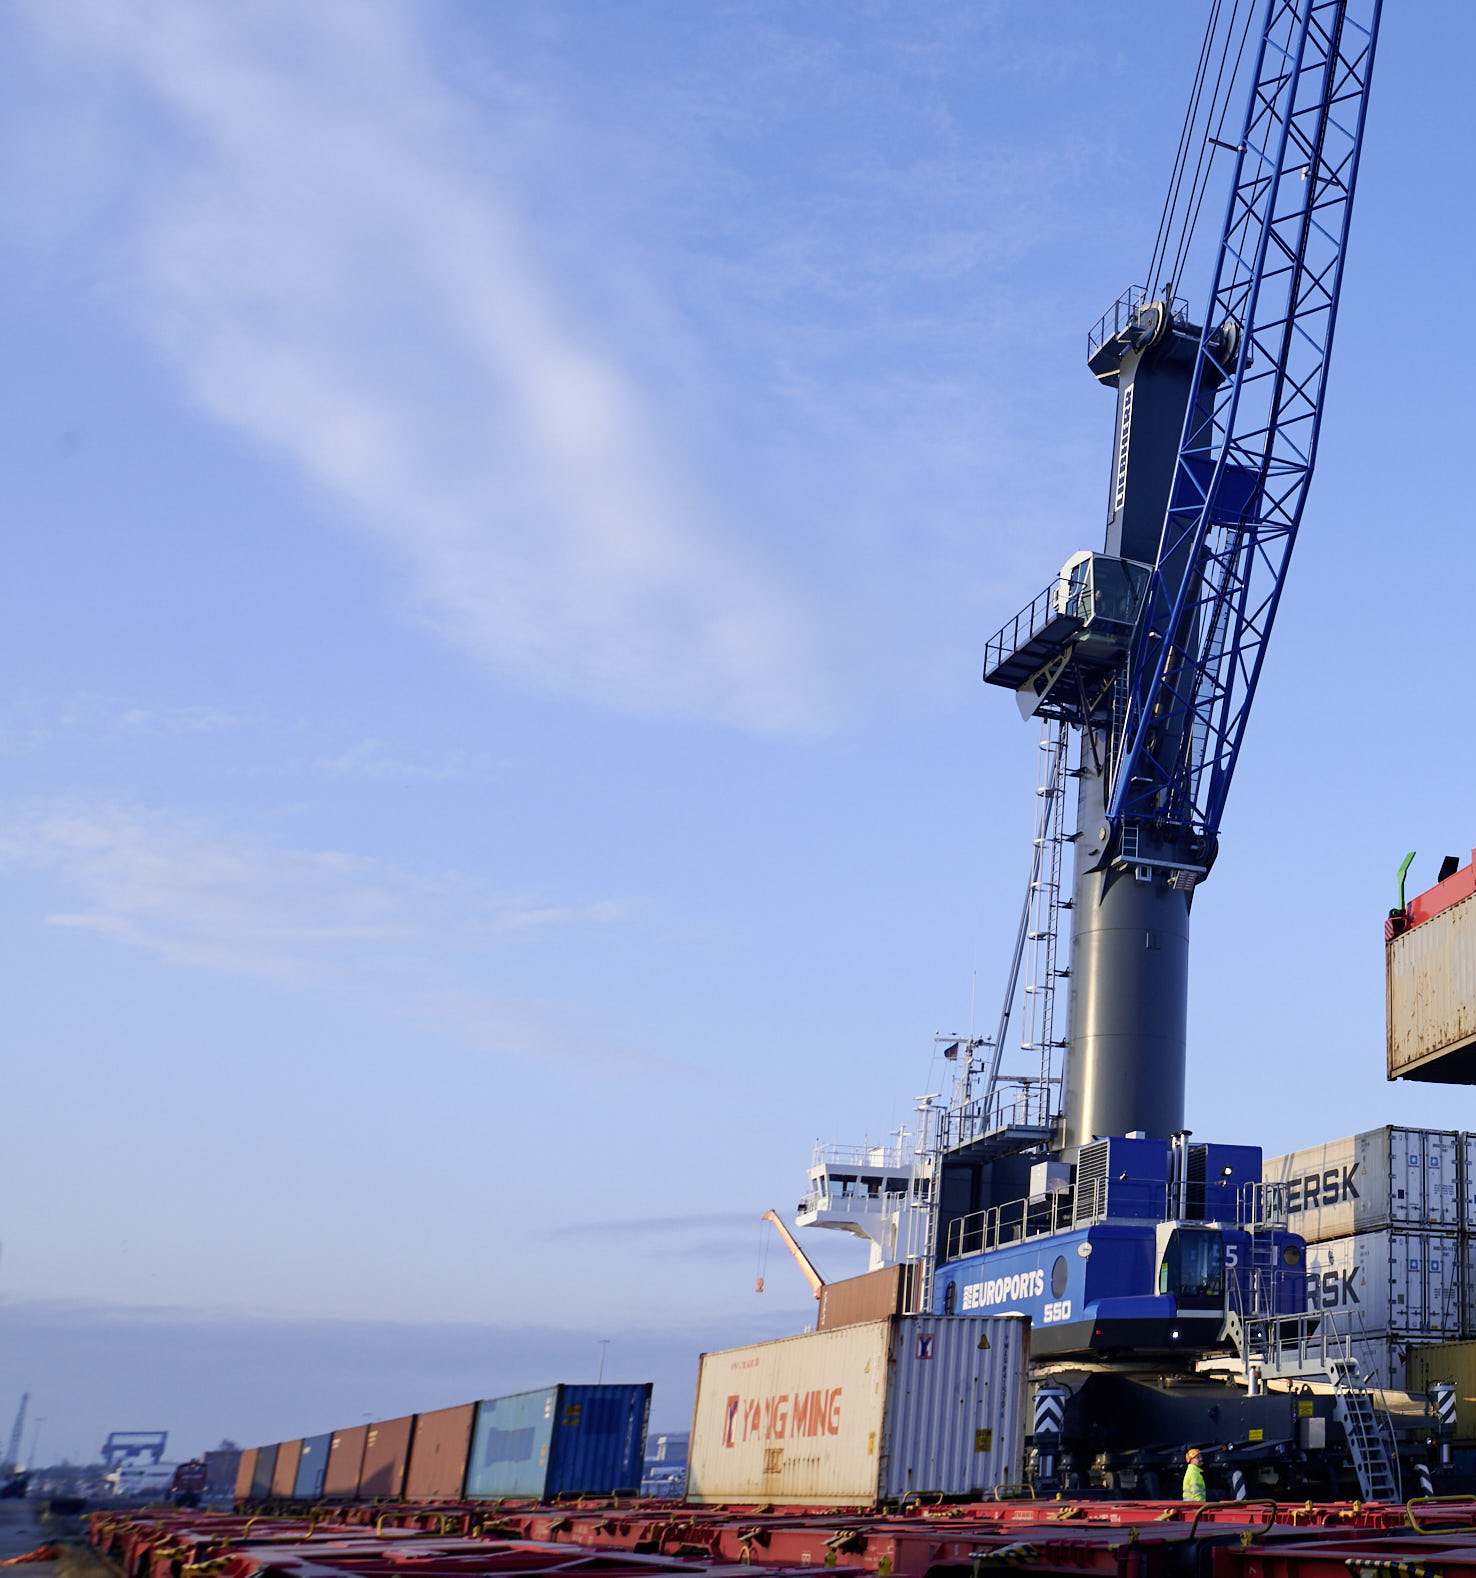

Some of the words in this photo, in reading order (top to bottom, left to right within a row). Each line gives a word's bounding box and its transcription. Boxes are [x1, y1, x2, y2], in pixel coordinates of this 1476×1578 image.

[1116, 390, 1132, 508] LIEBHERR
[1266, 1163, 1360, 1218] AERSK
[1225, 1245, 1238, 1267] 5
[971, 1269, 1044, 1310] EUROPORTS
[1306, 1266, 1360, 1310] RSK
[1043, 1300, 1071, 1323] 550
[742, 1394, 789, 1442] YANG
[790, 1387, 842, 1438] MING
